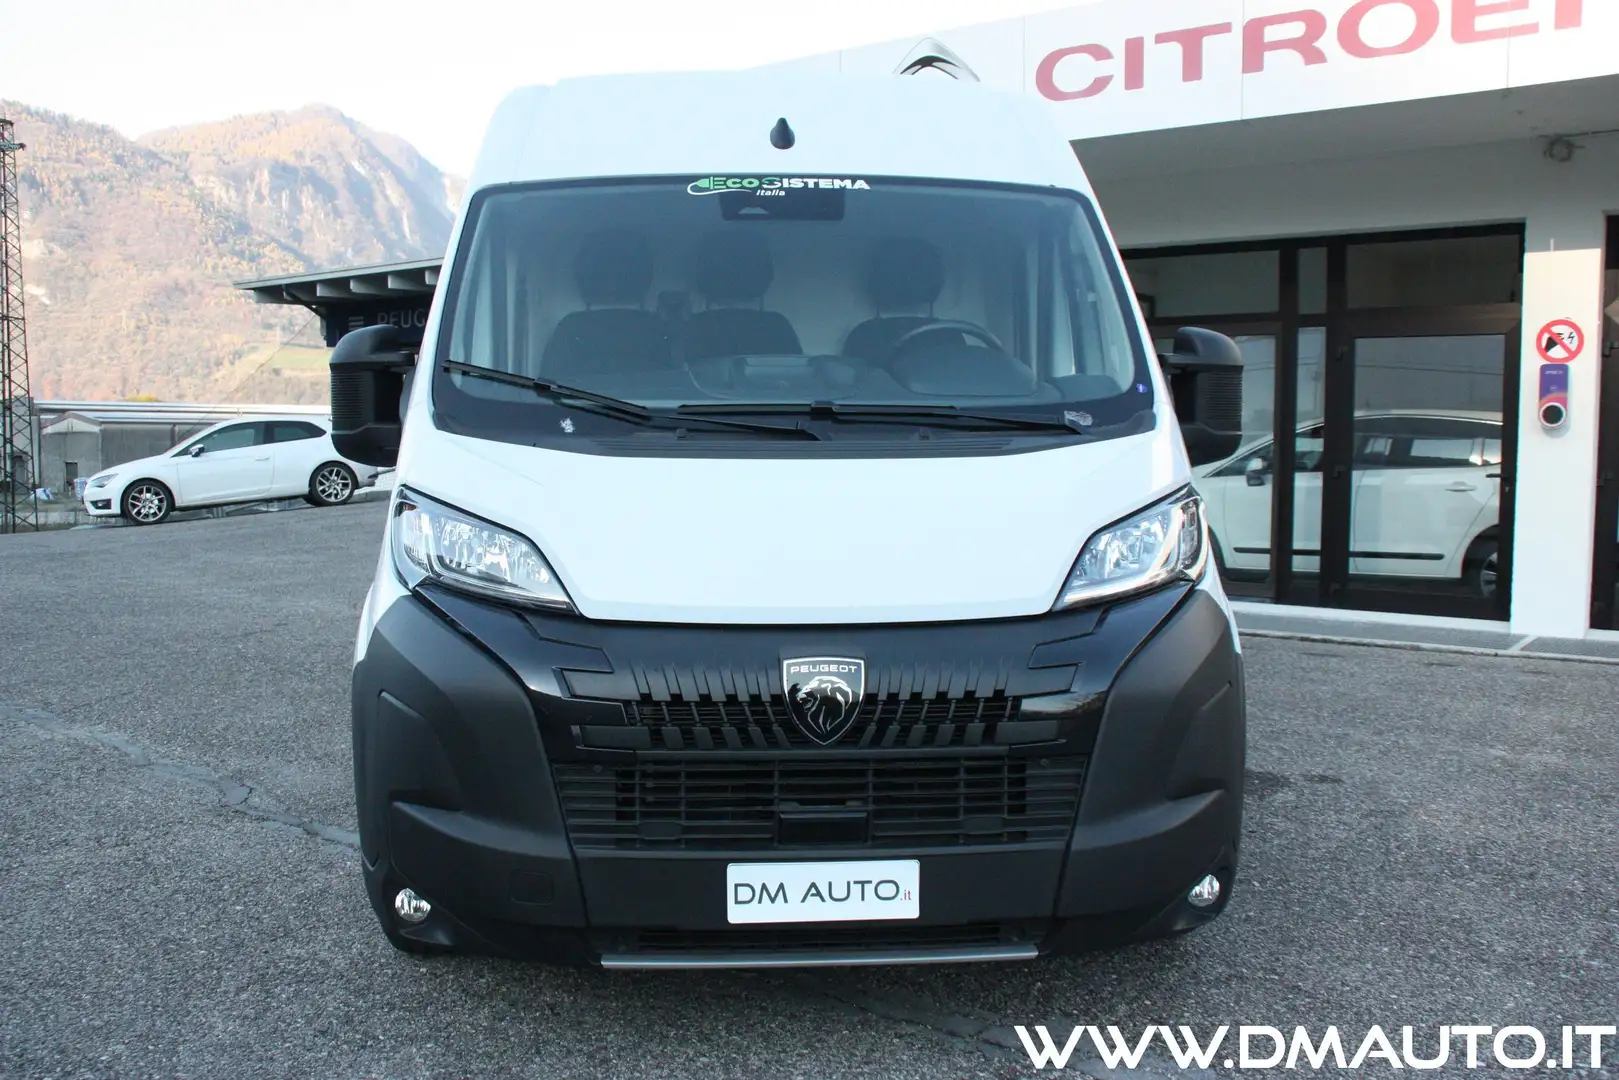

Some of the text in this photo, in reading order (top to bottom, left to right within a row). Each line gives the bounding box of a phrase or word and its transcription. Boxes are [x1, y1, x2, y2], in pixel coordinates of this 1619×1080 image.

[1036, 0, 1583, 101] CITROE
[712, 176, 871, 190] ECOSISTEMA
[790, 664, 858, 673] PEUGEOT
[734, 882, 789, 905] DM
